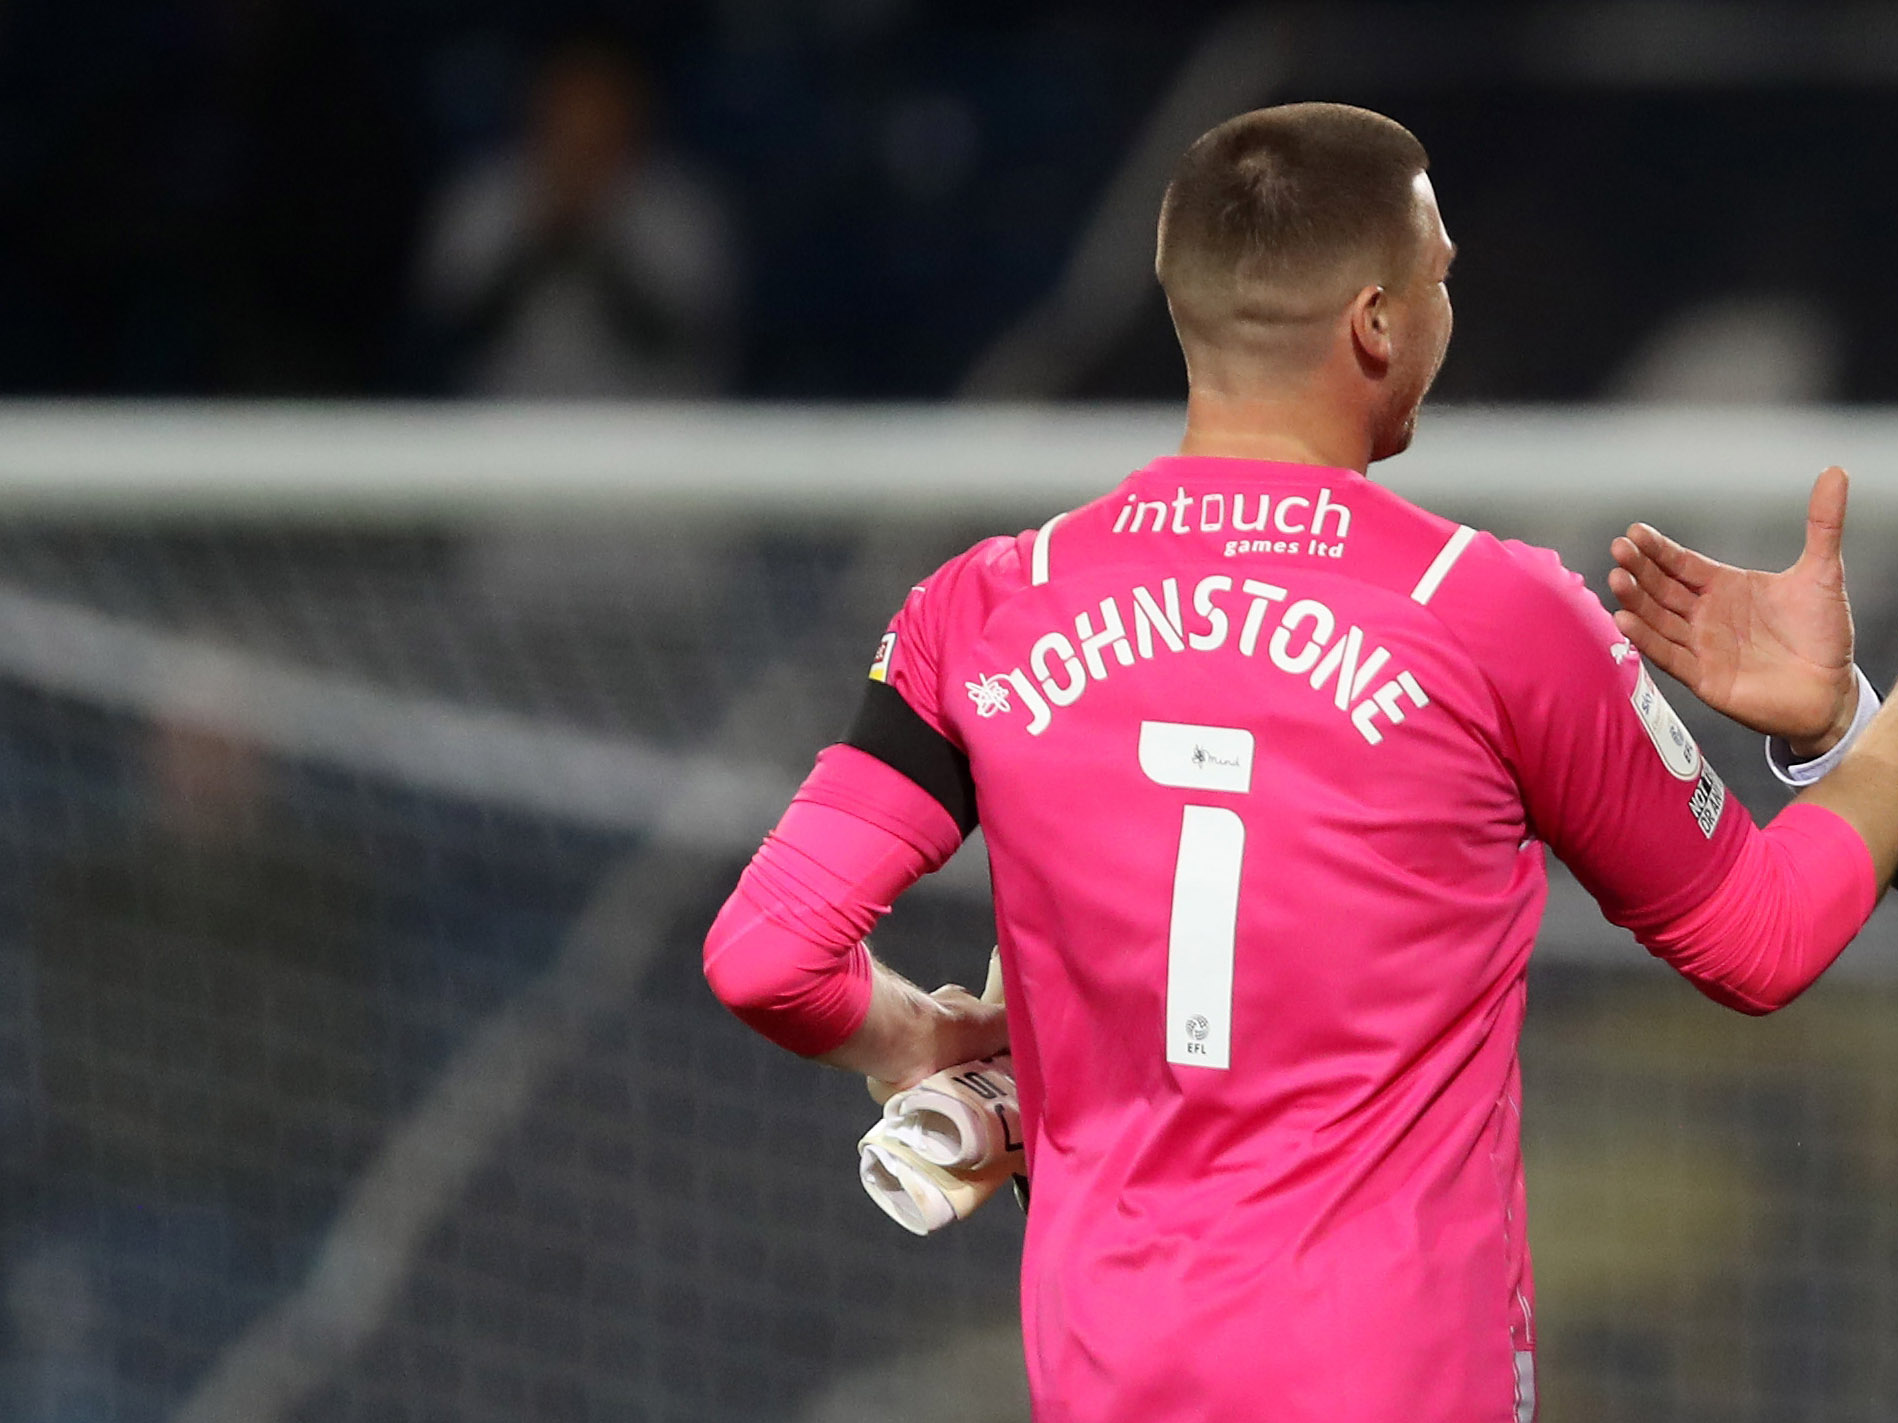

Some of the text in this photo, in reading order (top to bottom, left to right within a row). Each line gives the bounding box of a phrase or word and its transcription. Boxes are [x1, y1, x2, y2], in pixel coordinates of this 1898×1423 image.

[1224, 538, 1345, 559] games ltd
[1012, 575, 1430, 746] JOHNSTONE
[1137, 721, 1256, 1071] 1
[1186, 1042, 1207, 1055] EFL
